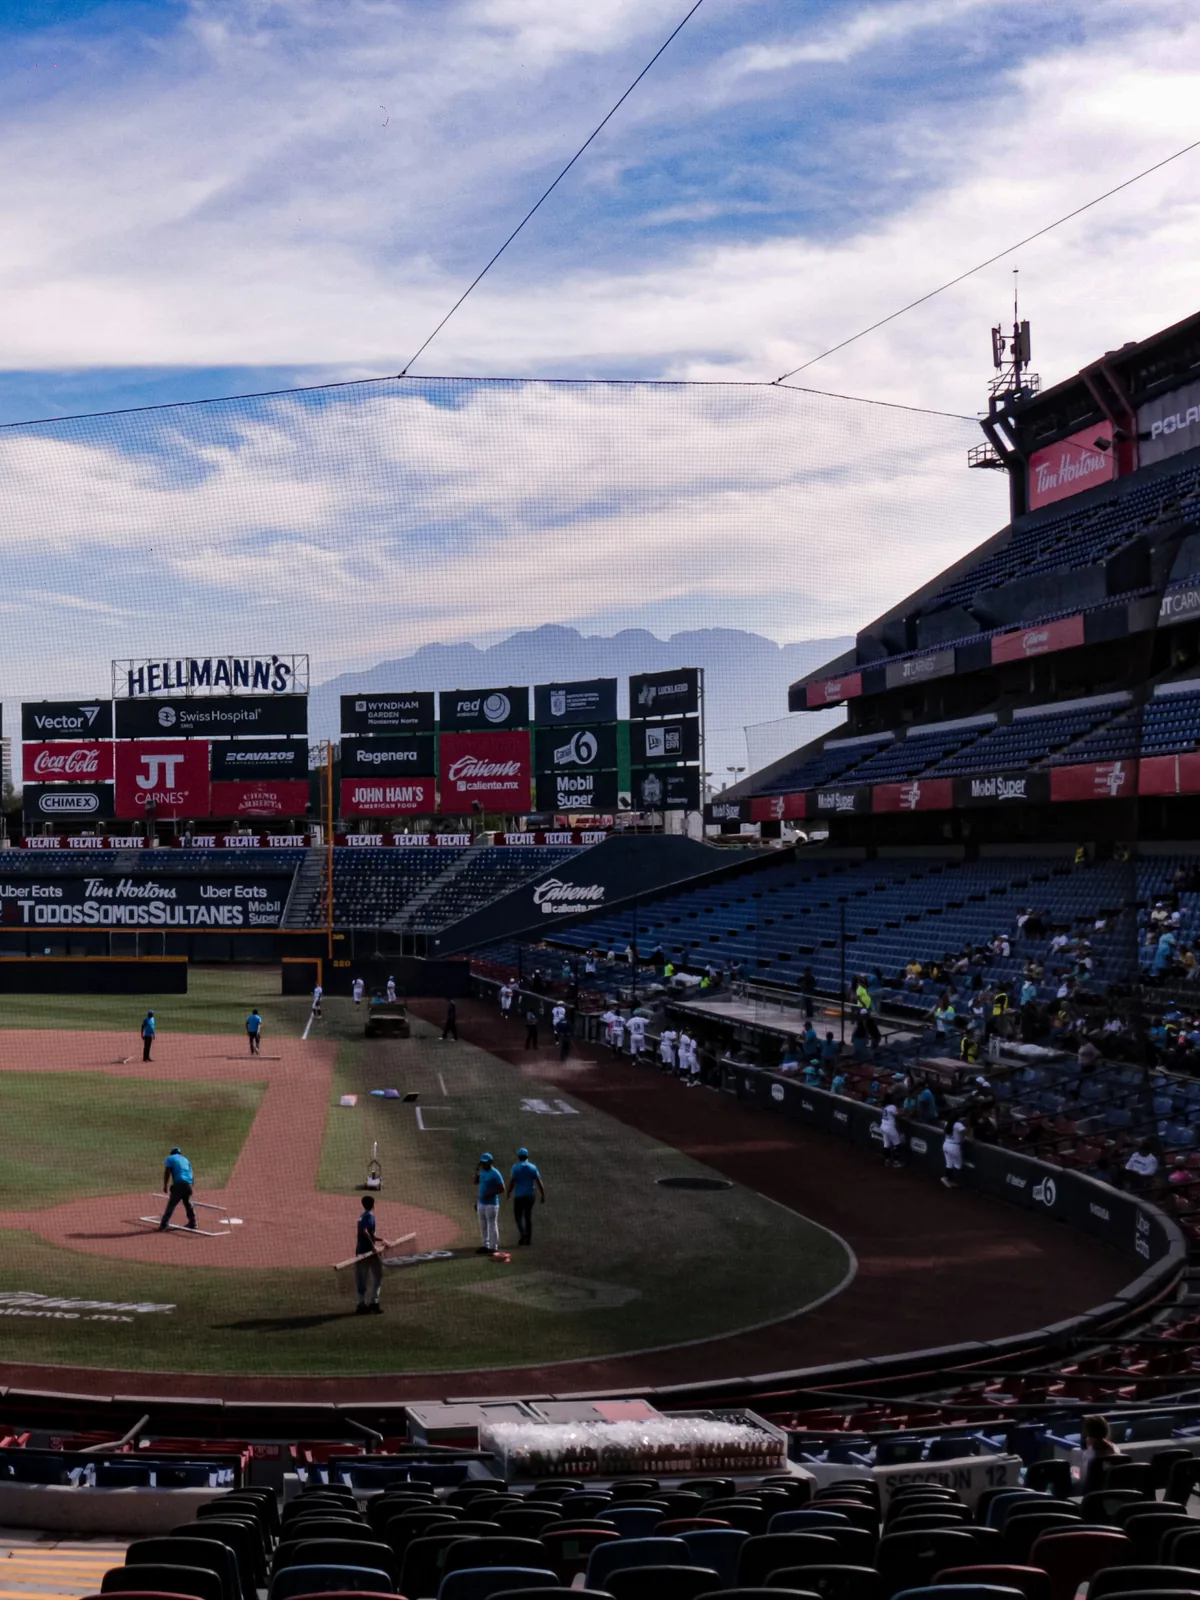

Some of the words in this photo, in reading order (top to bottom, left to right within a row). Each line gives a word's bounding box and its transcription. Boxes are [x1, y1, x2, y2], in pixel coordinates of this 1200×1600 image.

[1151, 404, 1200, 440] POLA
[1035, 462, 1056, 494] Tim
[1058, 450, 1106, 484] Hortons
[127, 655, 291, 697] HELLMANN'S
[368, 701, 419, 710] WYNDHAM
[457, 698, 480, 711] red
[34, 715, 84, 729] Vector
[34, 749, 100, 774] Coca-Cola
[236, 751, 295, 761] CAVAZOS
[357, 750, 417, 764] Regenera
[136, 754, 184, 789] JT
[448, 755, 521, 781] Caliente
[467, 781, 518, 790] caliente.mx
[557, 776, 593, 791] Mobil
[971, 777, 996, 797] Mobil
[997, 776, 1026, 797] Super
[135, 792, 184, 804] CARNES
[352, 788, 383, 803] JOHN
[386, 786, 424, 802] HAM'S
[557, 793, 593, 806] Super
[44, 798, 91, 808] CHIMEX
[25, 836, 61, 848] TECATE
[67, 836, 103, 848] TECATE
[108, 836, 144, 848] TECATE
[179, 836, 215, 848] TCATE
[223, 836, 260, 847] TECATE
[267, 835, 304, 847] TECATE
[345, 834, 382, 846] TECATE
[393, 834, 429, 845] TECATE
[435, 834, 471, 845] TECATE
[503, 833, 536, 844] TECATE
[544, 832, 573, 844] TECATE
[0, 885, 30, 897] Uber
[32, 885, 63, 897] Eats
[84, 878, 113, 898] Tim
[115, 879, 177, 899] Hortons
[200, 886, 231, 898] Uber
[233, 886, 267, 898] Eats
[533, 878, 605, 904] Caliente
[248, 901, 280, 912] Mobil
[248, 912, 280, 924] Super
[985, 1465, 1007, 1486] 12
